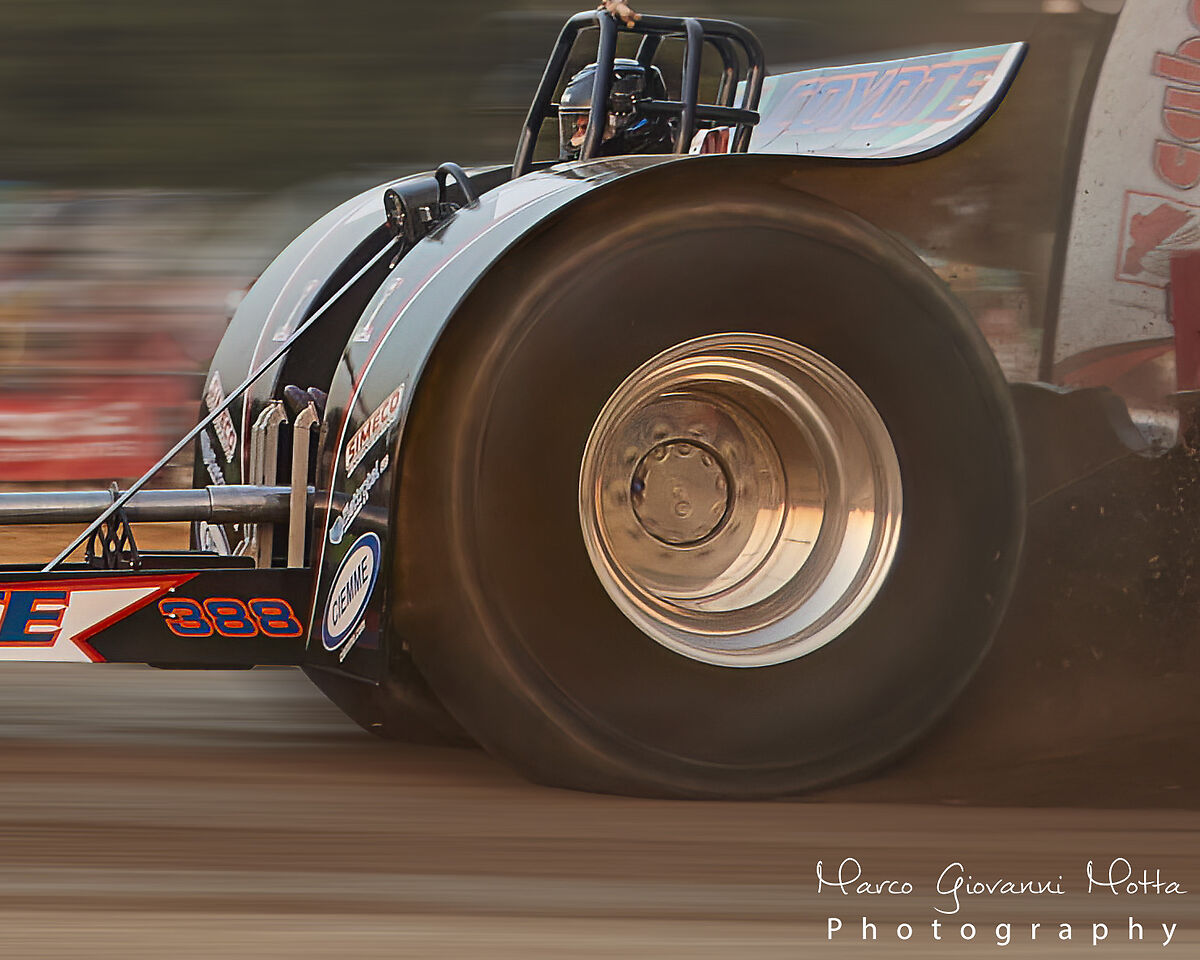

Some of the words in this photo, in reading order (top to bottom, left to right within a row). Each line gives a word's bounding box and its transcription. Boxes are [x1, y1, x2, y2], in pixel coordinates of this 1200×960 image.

[772, 54, 1002, 132] COYOTE
[158, 597, 303, 637] 388
[331, 554, 369, 626] CIEMME
